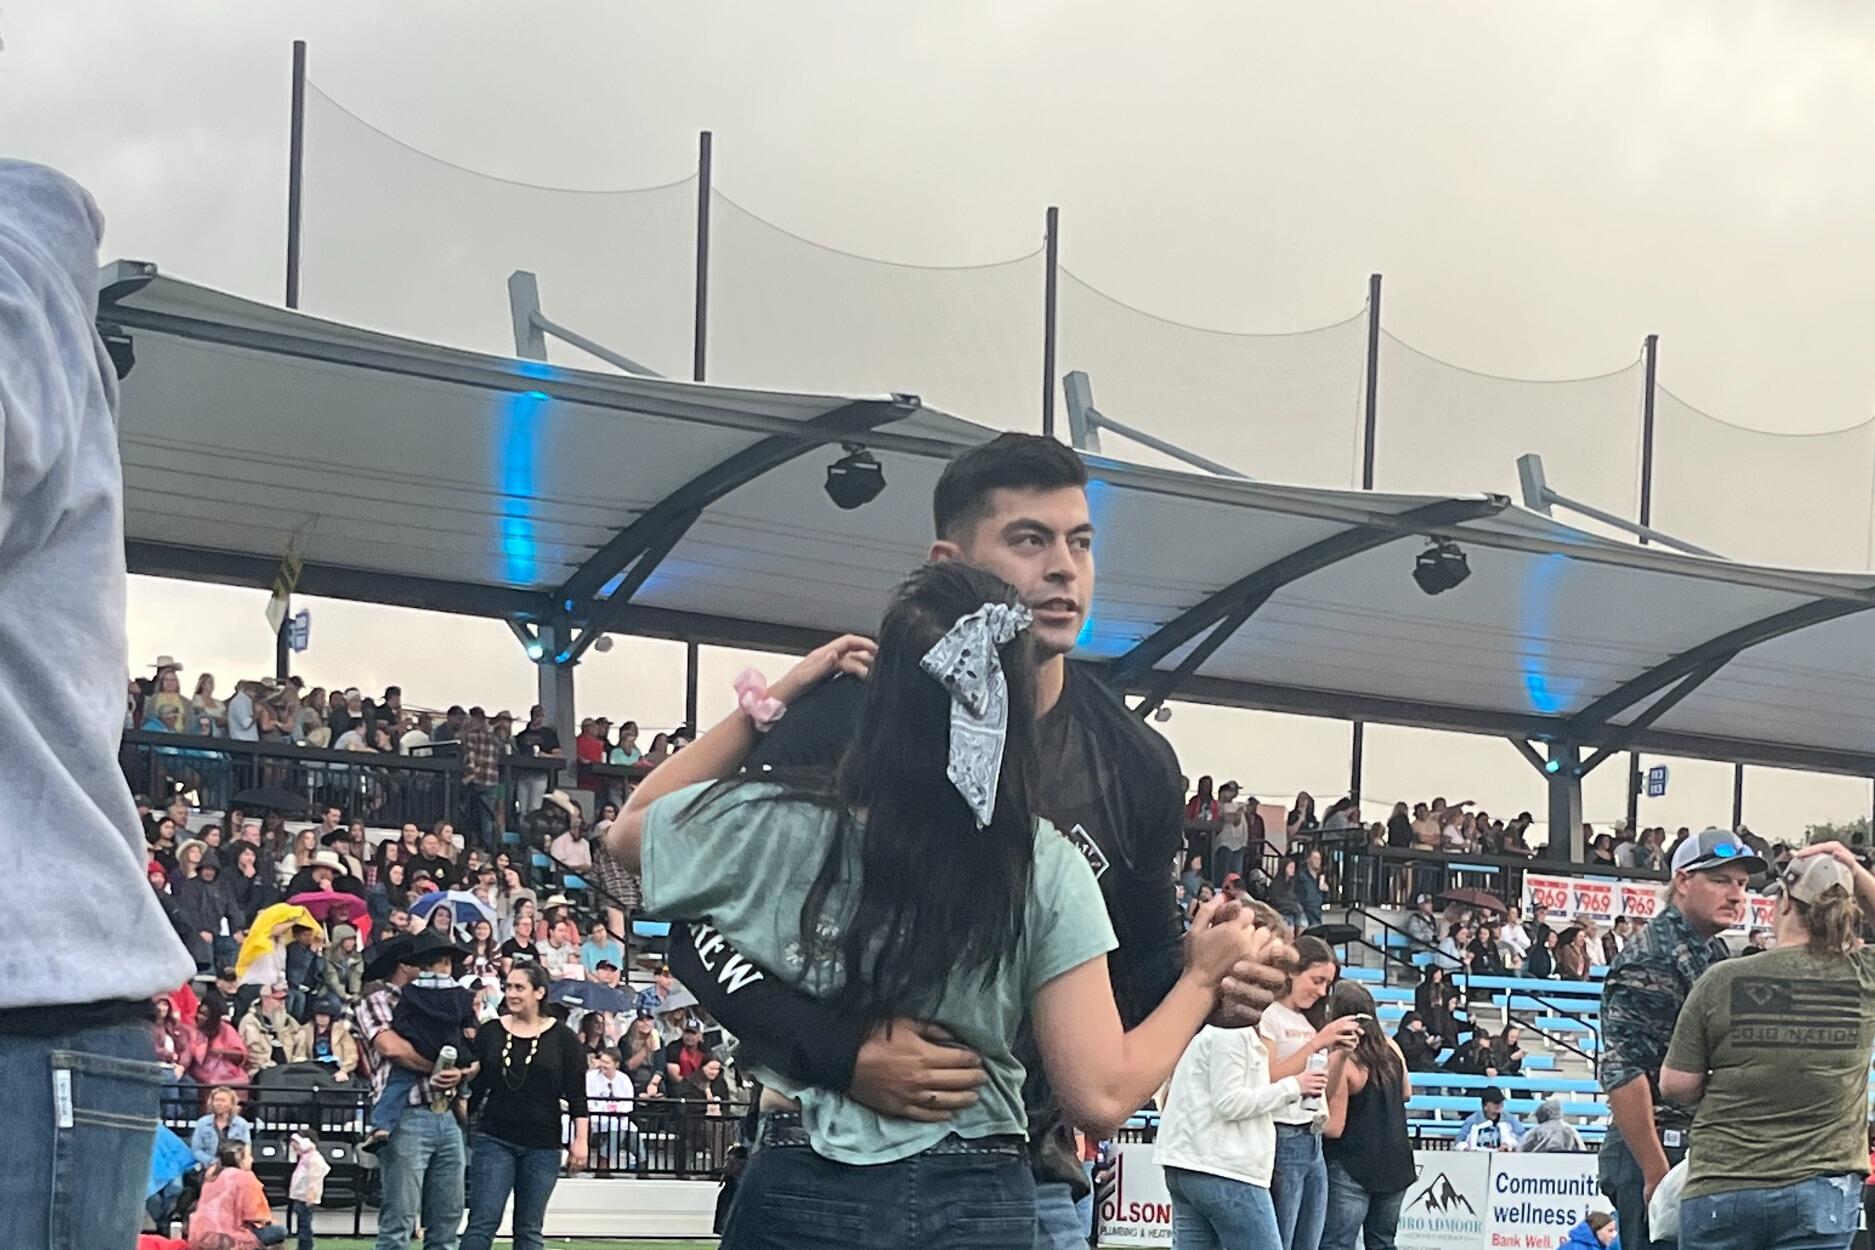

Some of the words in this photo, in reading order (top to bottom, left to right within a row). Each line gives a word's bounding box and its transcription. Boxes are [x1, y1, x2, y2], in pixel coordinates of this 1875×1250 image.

[1494, 1202, 1577, 1226] wellness
[1491, 1233, 1521, 1247] Bank
[1525, 1234, 1553, 1249] Well.
